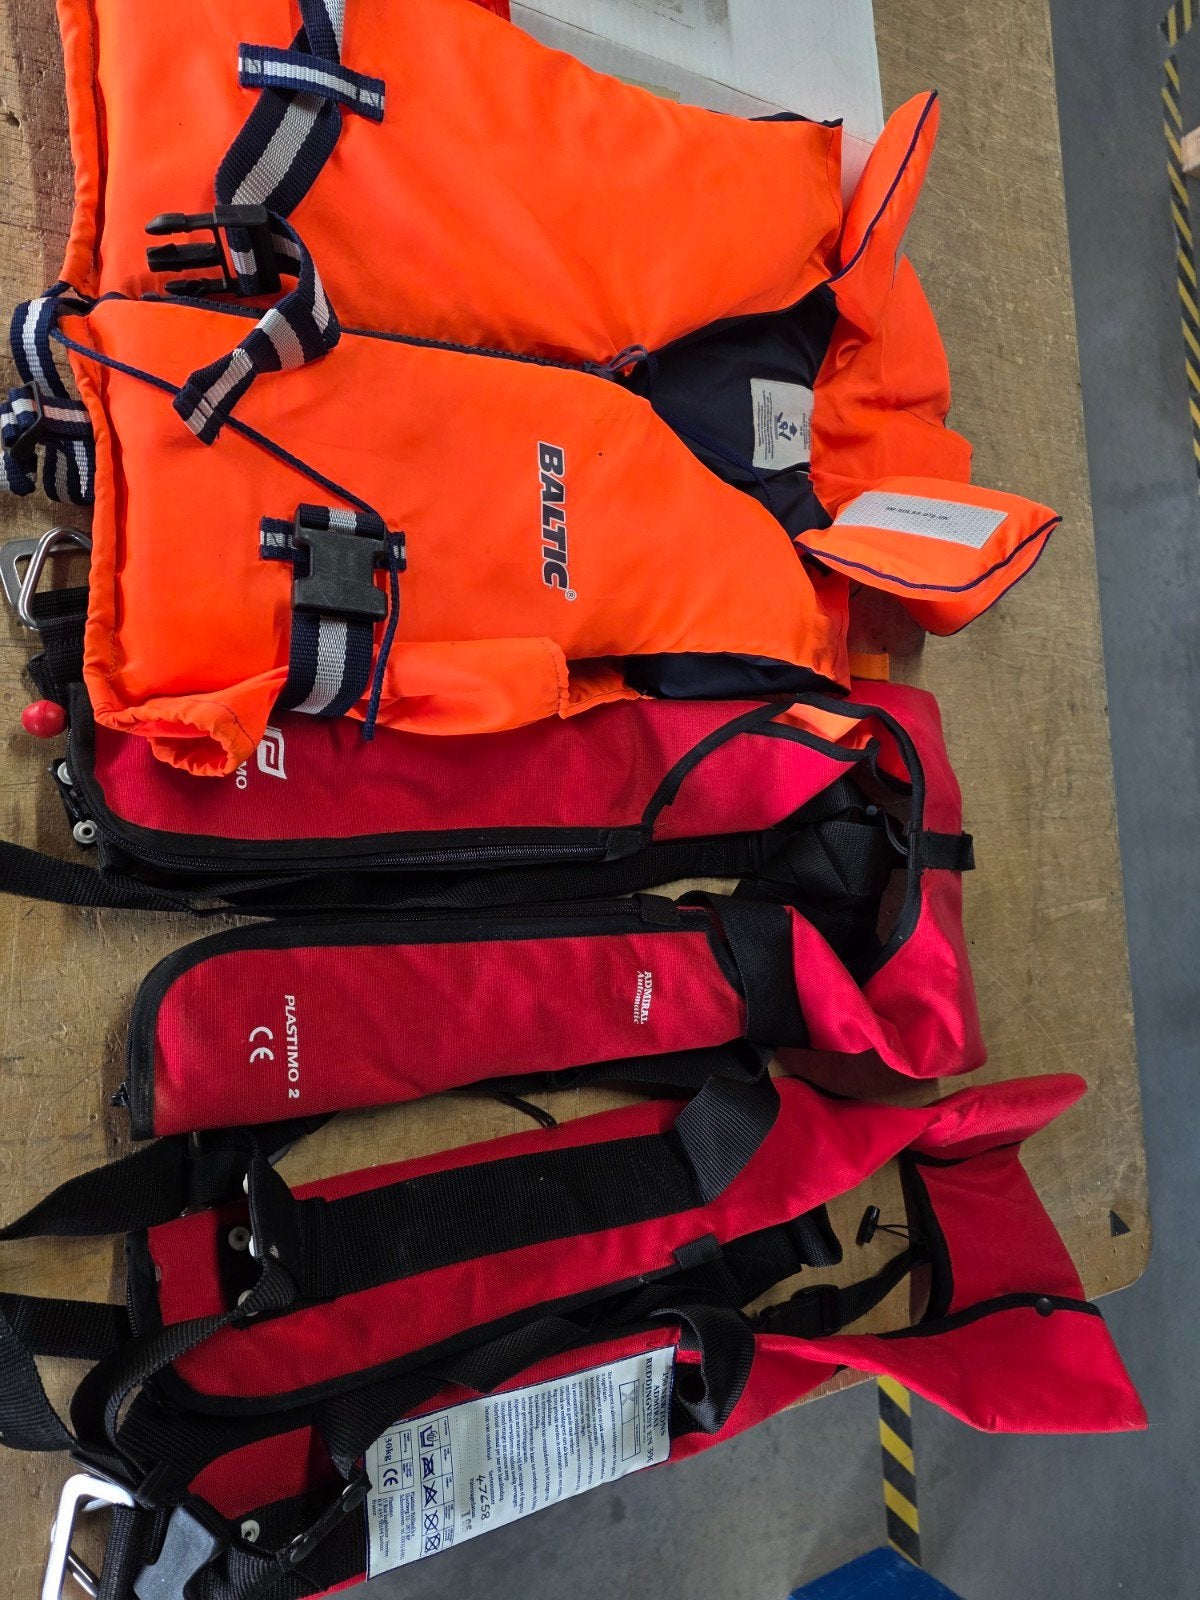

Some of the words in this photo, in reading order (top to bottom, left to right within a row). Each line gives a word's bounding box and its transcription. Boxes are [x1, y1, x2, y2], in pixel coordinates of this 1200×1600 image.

[633, 971, 645, 1025] Automatic
[641, 971, 652, 1025] ADMIRAL
[249, 1026, 274, 1063] CE
[284, 995, 299, 1082] PLASTIMO
[288, 1088, 299, 1099] 2
[383, 1438, 393, 1462] 30kg
[646, 1431, 652, 1445] EN
[382, 1469, 398, 1487] CE
[476, 1475, 490, 1520] 47658
